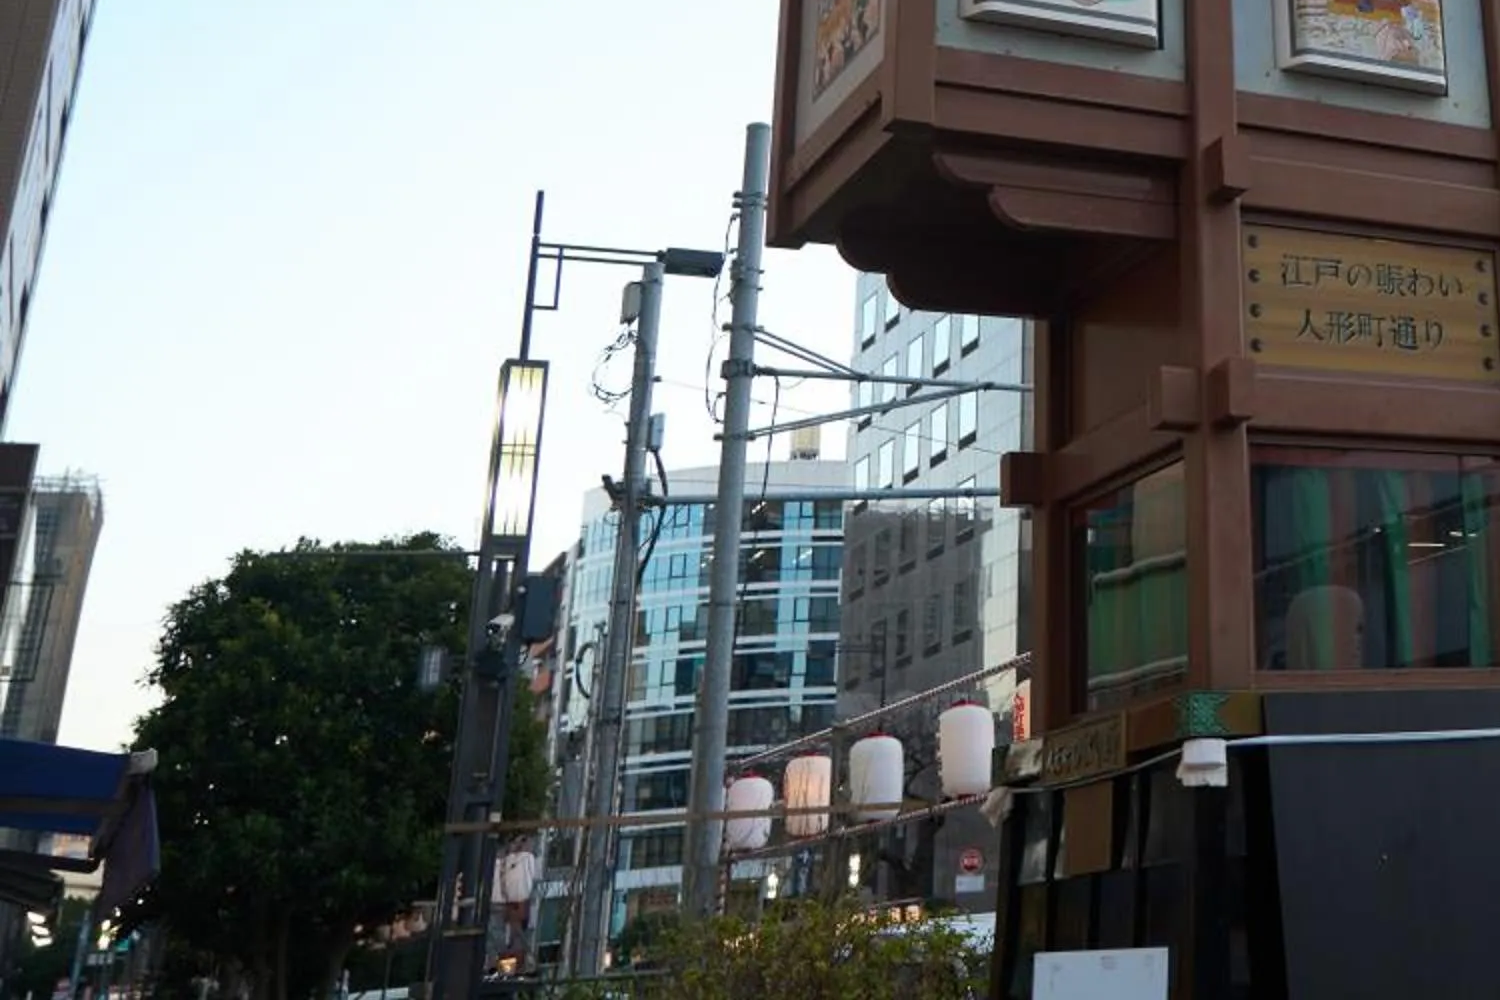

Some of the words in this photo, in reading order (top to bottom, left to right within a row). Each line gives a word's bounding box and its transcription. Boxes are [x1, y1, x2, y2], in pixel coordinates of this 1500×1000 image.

[1280, 254, 1463, 296] 江戸の賑わい
[1297, 308, 1444, 350] 人形町通り
